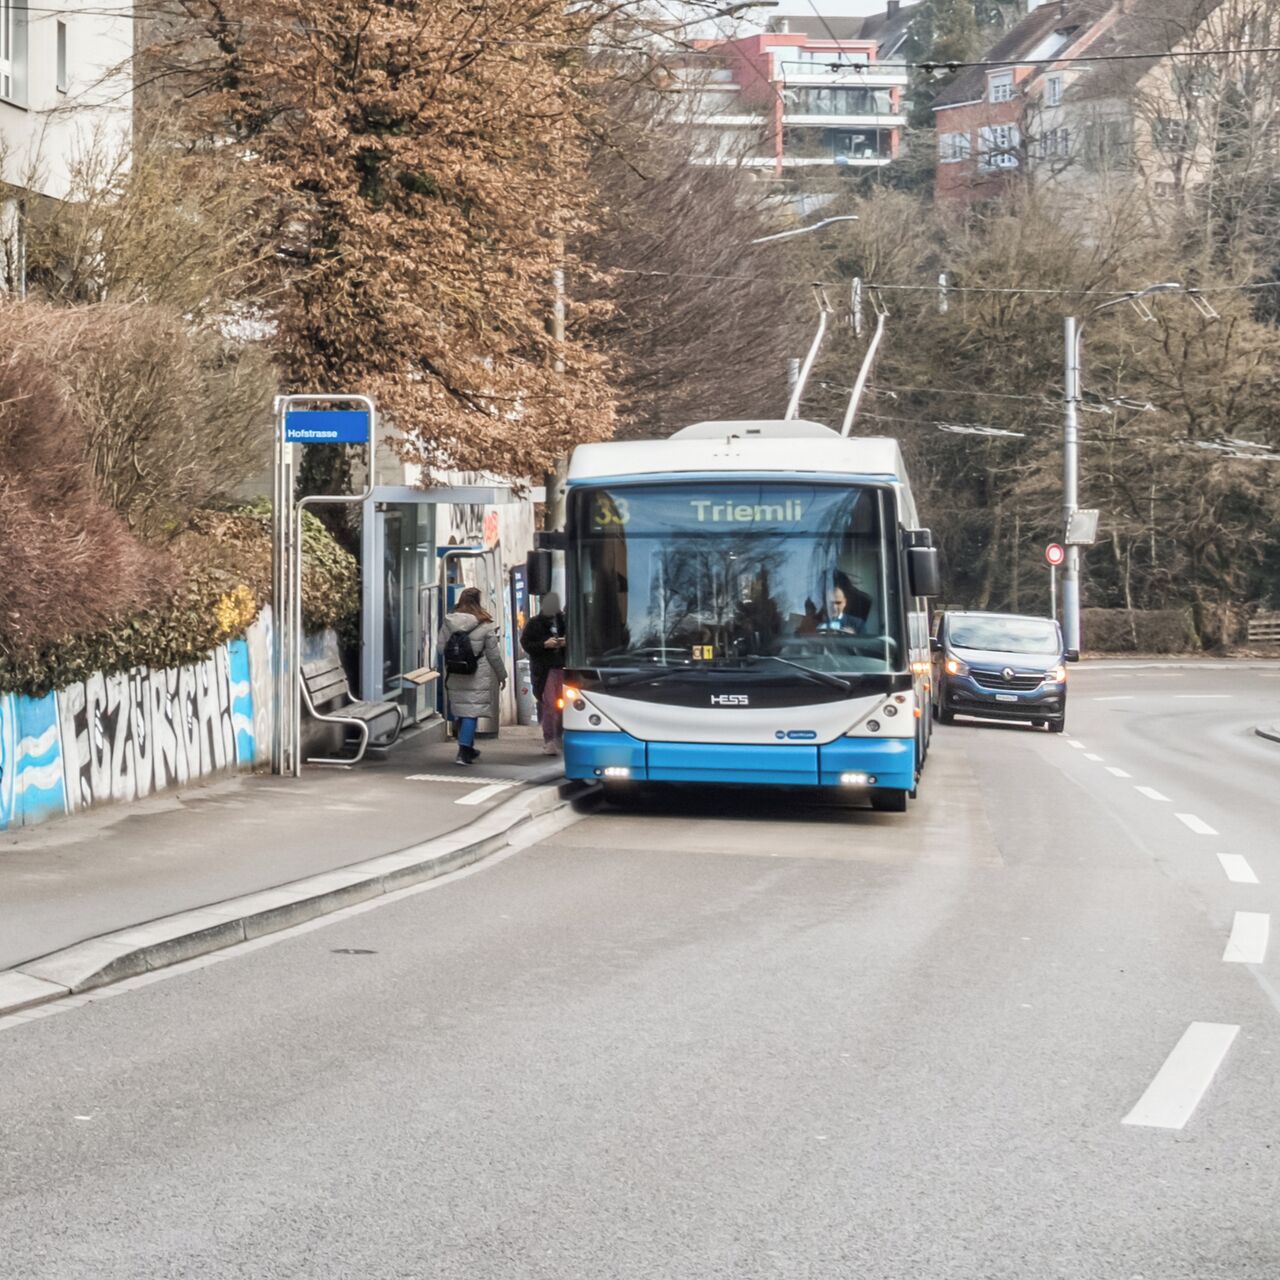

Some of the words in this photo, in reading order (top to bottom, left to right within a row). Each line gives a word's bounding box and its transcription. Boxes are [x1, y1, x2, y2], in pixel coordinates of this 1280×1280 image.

[287, 428, 338, 438] Hofstrasse
[595, 496, 630, 525] 33
[691, 500, 802, 521] Triemli
[711, 695, 749, 705] HESS
